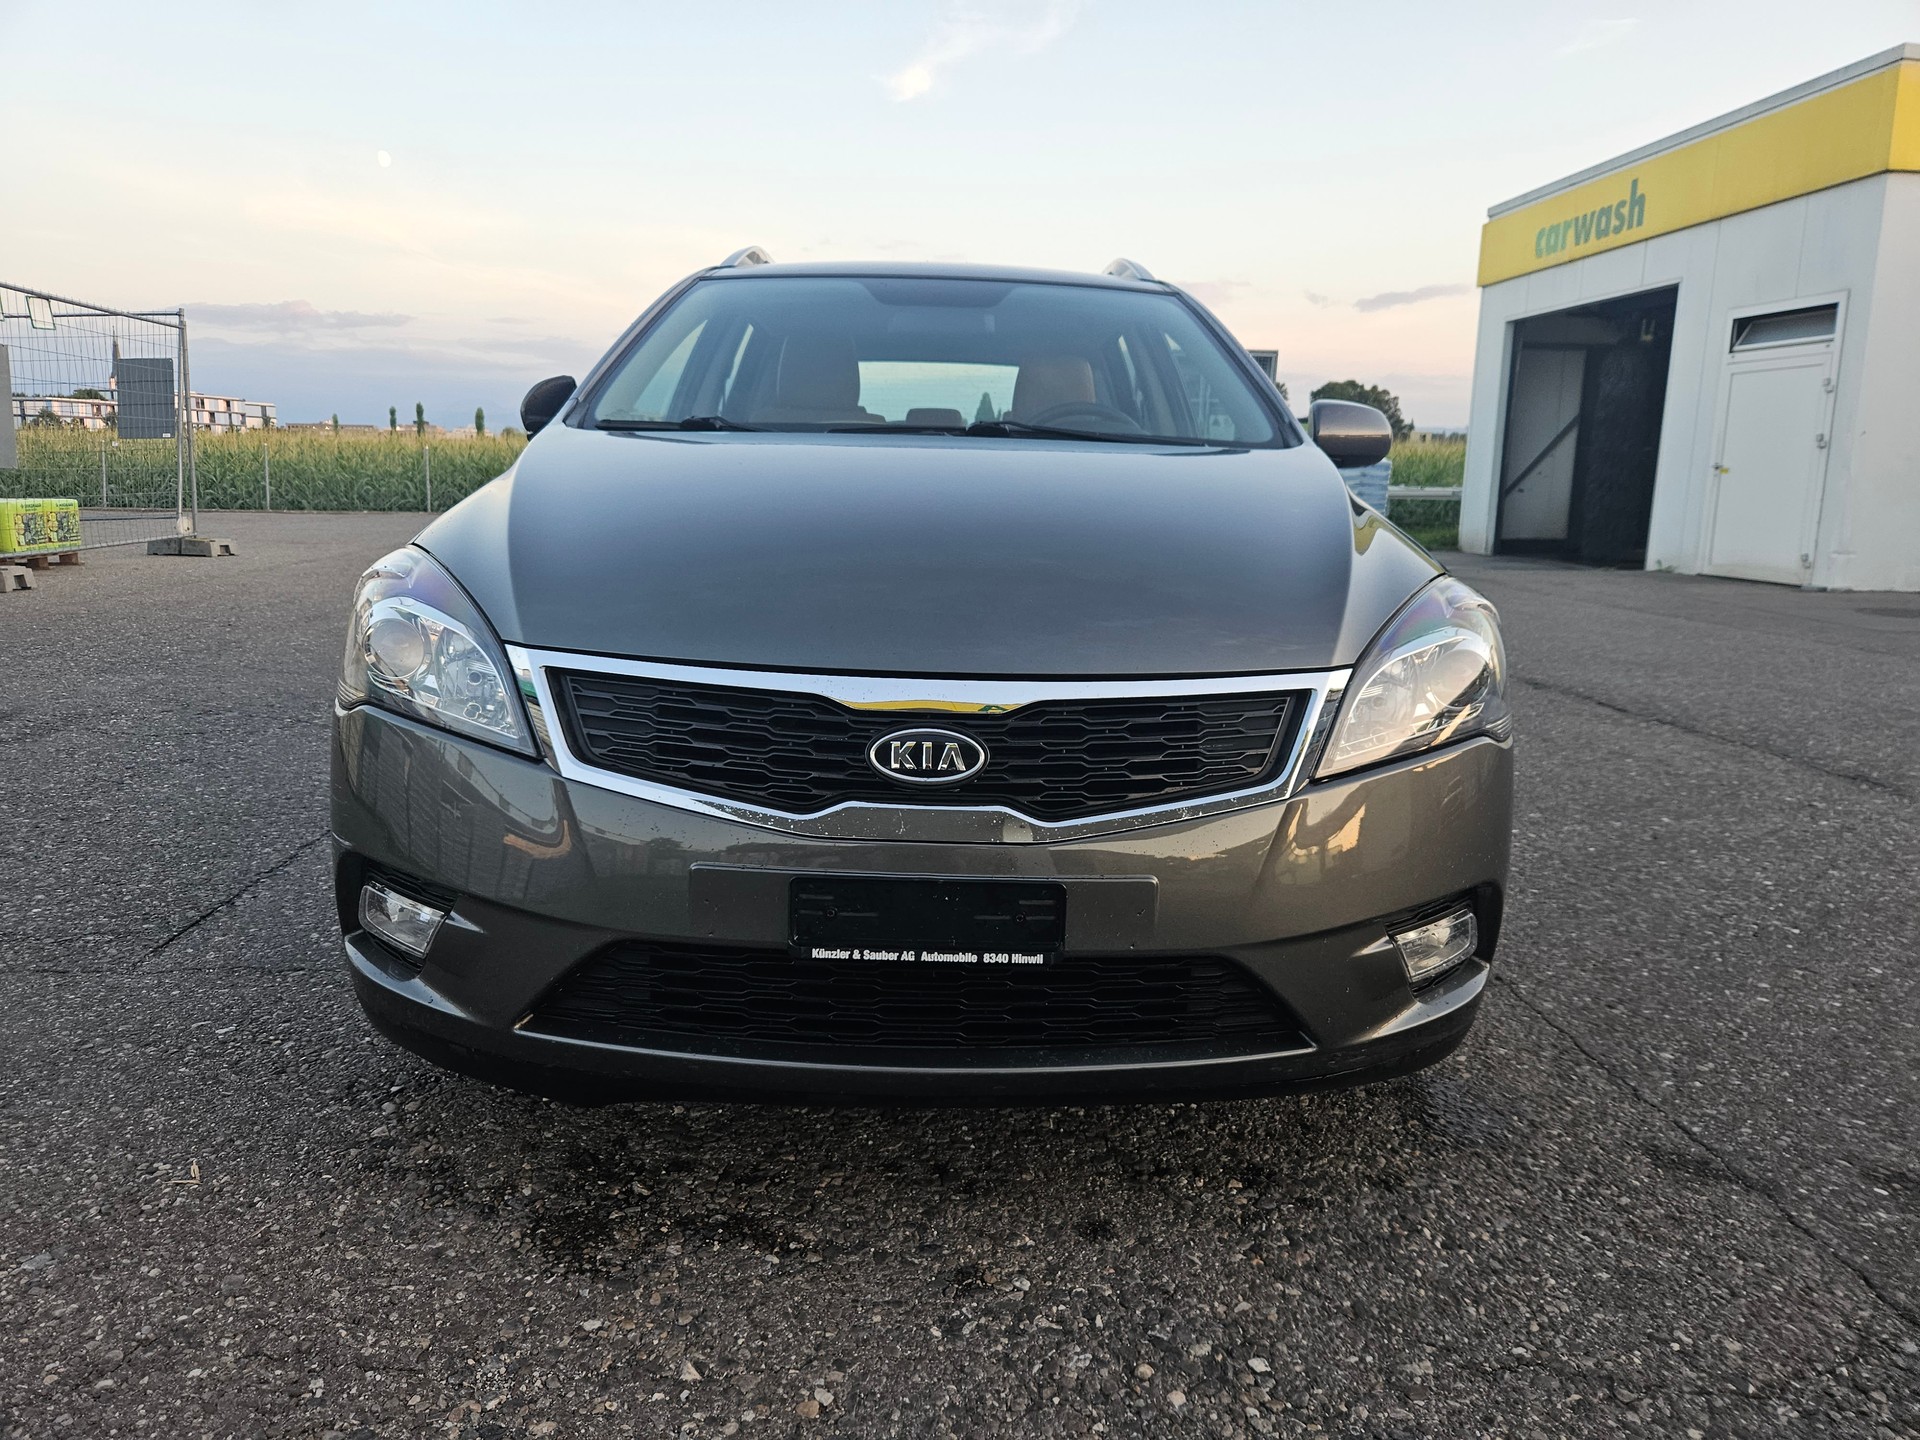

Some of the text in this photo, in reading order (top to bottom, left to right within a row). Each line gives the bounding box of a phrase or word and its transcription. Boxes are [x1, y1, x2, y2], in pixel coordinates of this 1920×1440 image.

[1535, 178, 1646, 258] carwash
[890, 741, 966, 771] KIA
[811, 948, 1044, 964] Künzler & Sauber AG Automobile 8340 Hinwil
